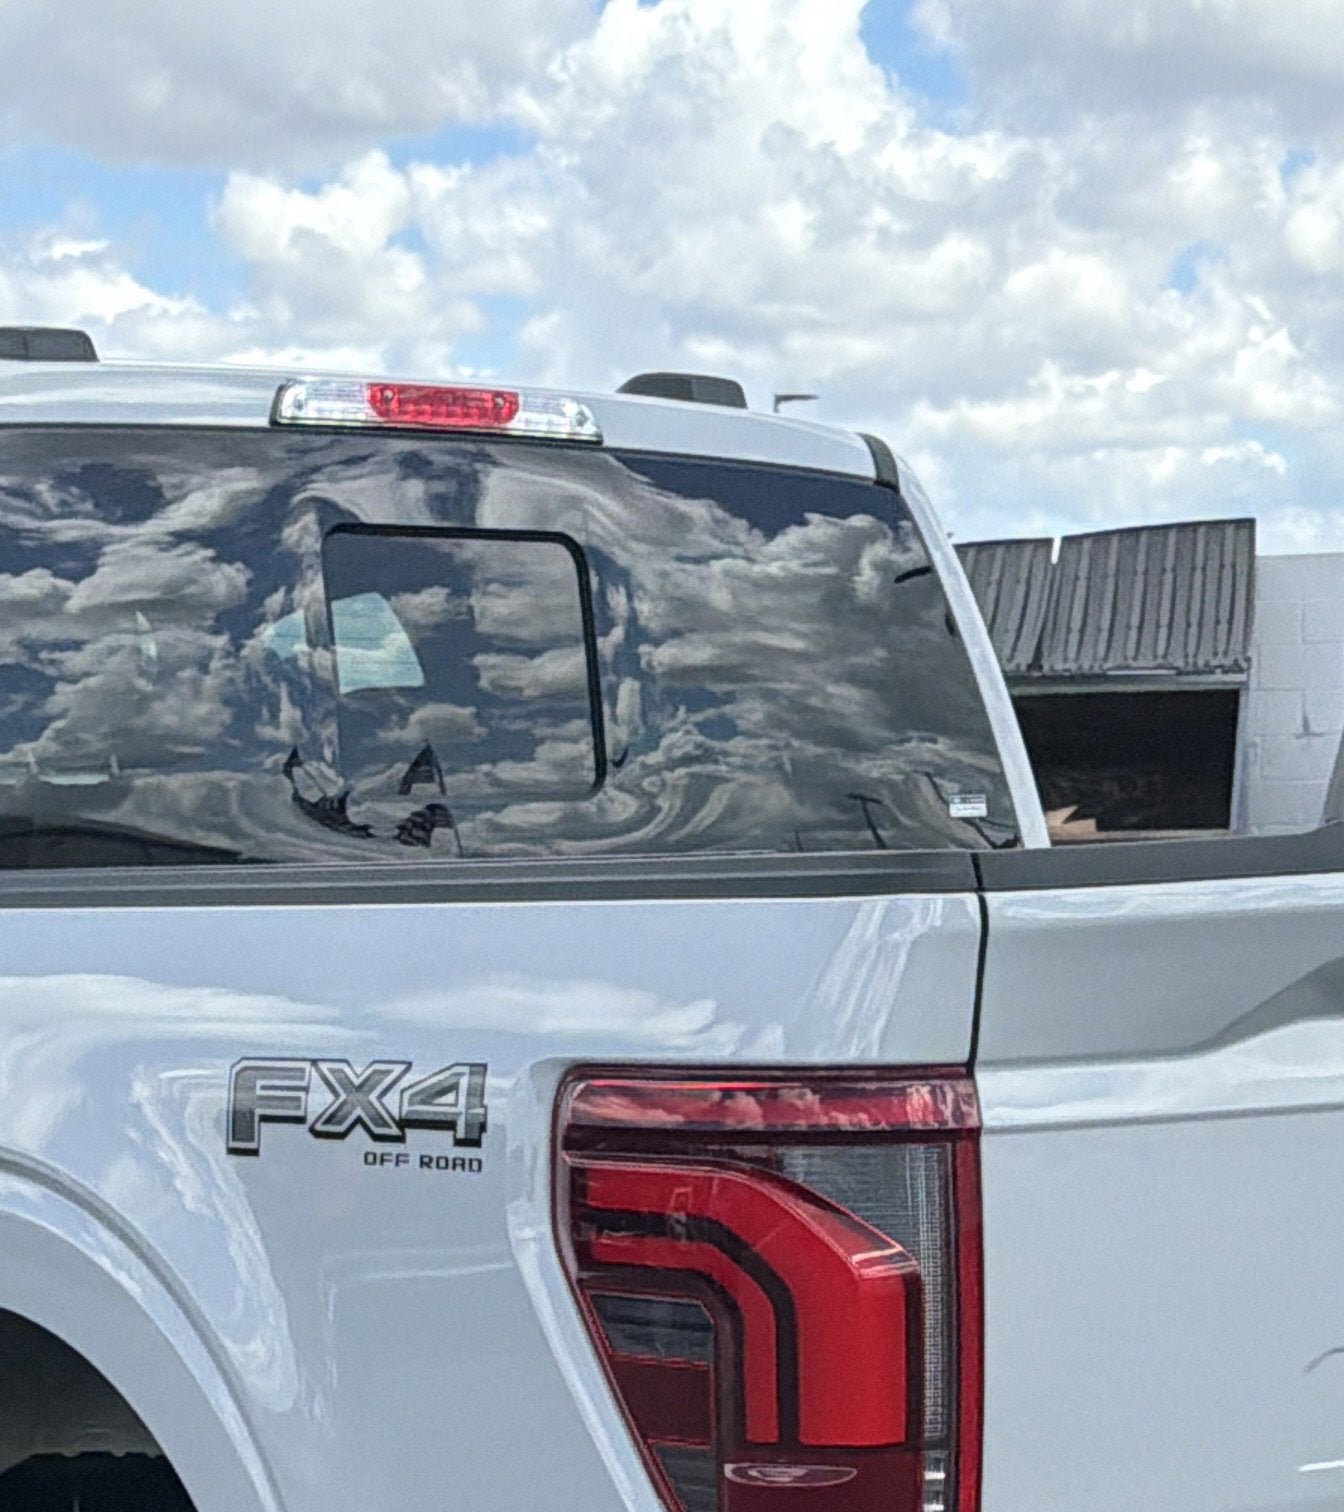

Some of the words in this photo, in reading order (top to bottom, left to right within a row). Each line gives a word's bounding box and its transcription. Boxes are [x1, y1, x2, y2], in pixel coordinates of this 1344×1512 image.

[226, 1057, 487, 1156] FX4
[363, 1150, 410, 1168] OFF
[419, 1153, 484, 1174] ROAD
